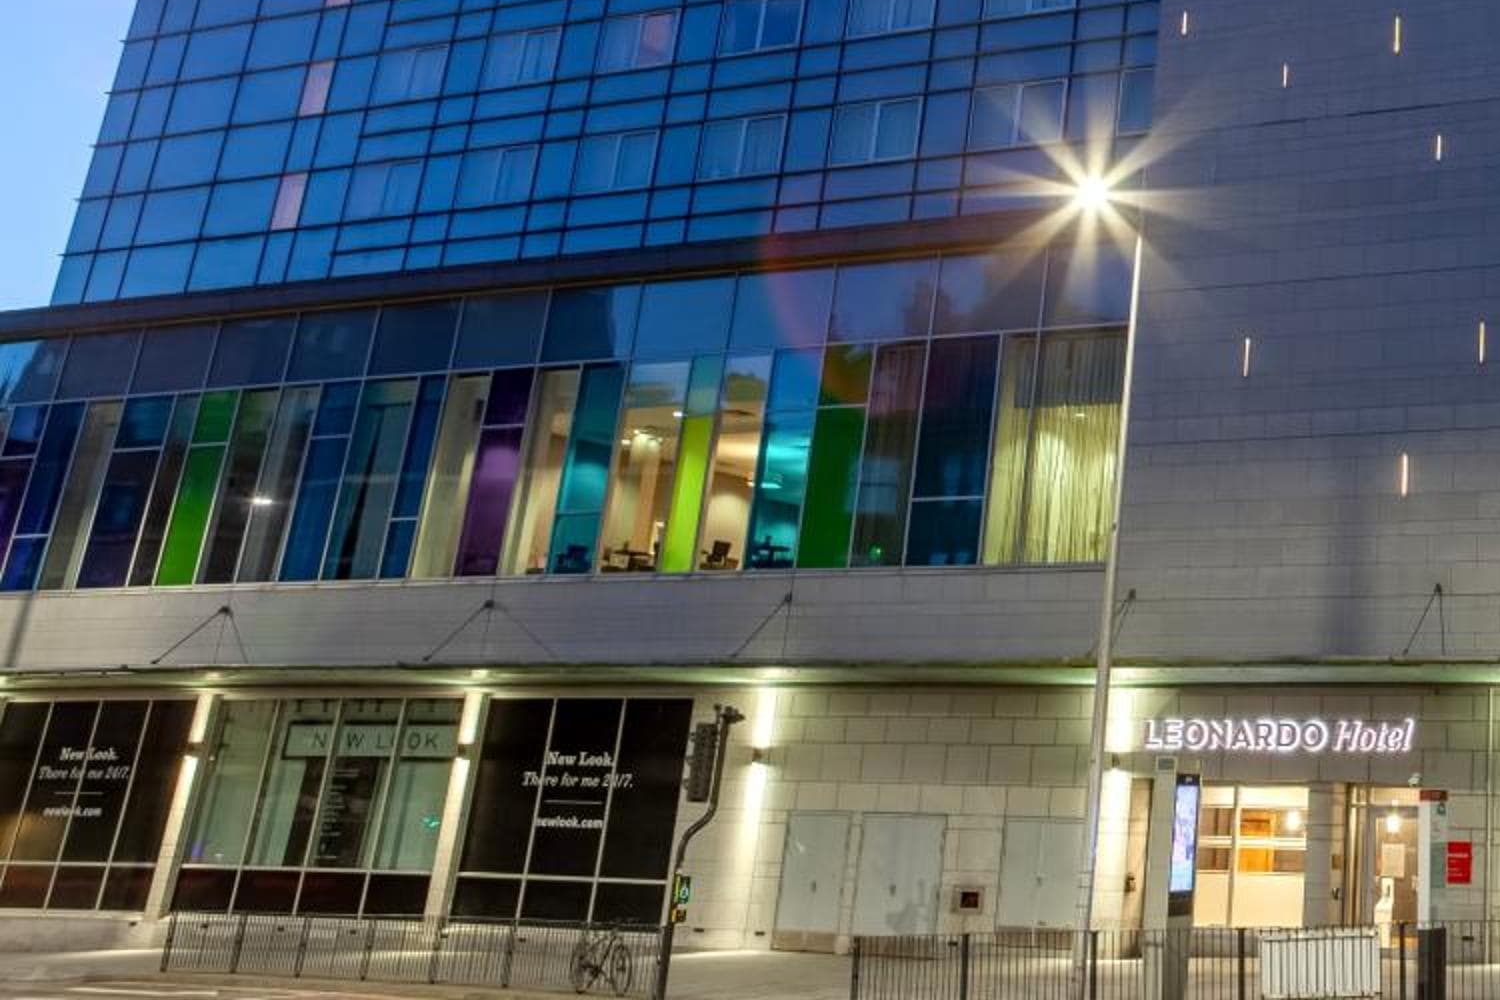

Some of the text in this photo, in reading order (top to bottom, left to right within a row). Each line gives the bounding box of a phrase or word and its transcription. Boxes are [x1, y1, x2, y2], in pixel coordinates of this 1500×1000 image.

[312, 732, 365, 749] NW
[1144, 718, 1416, 752] LEONARDO Hotel
[543, 751, 577, 766] New
[560, 772, 579, 787] for
[580, 777, 601, 788] me
